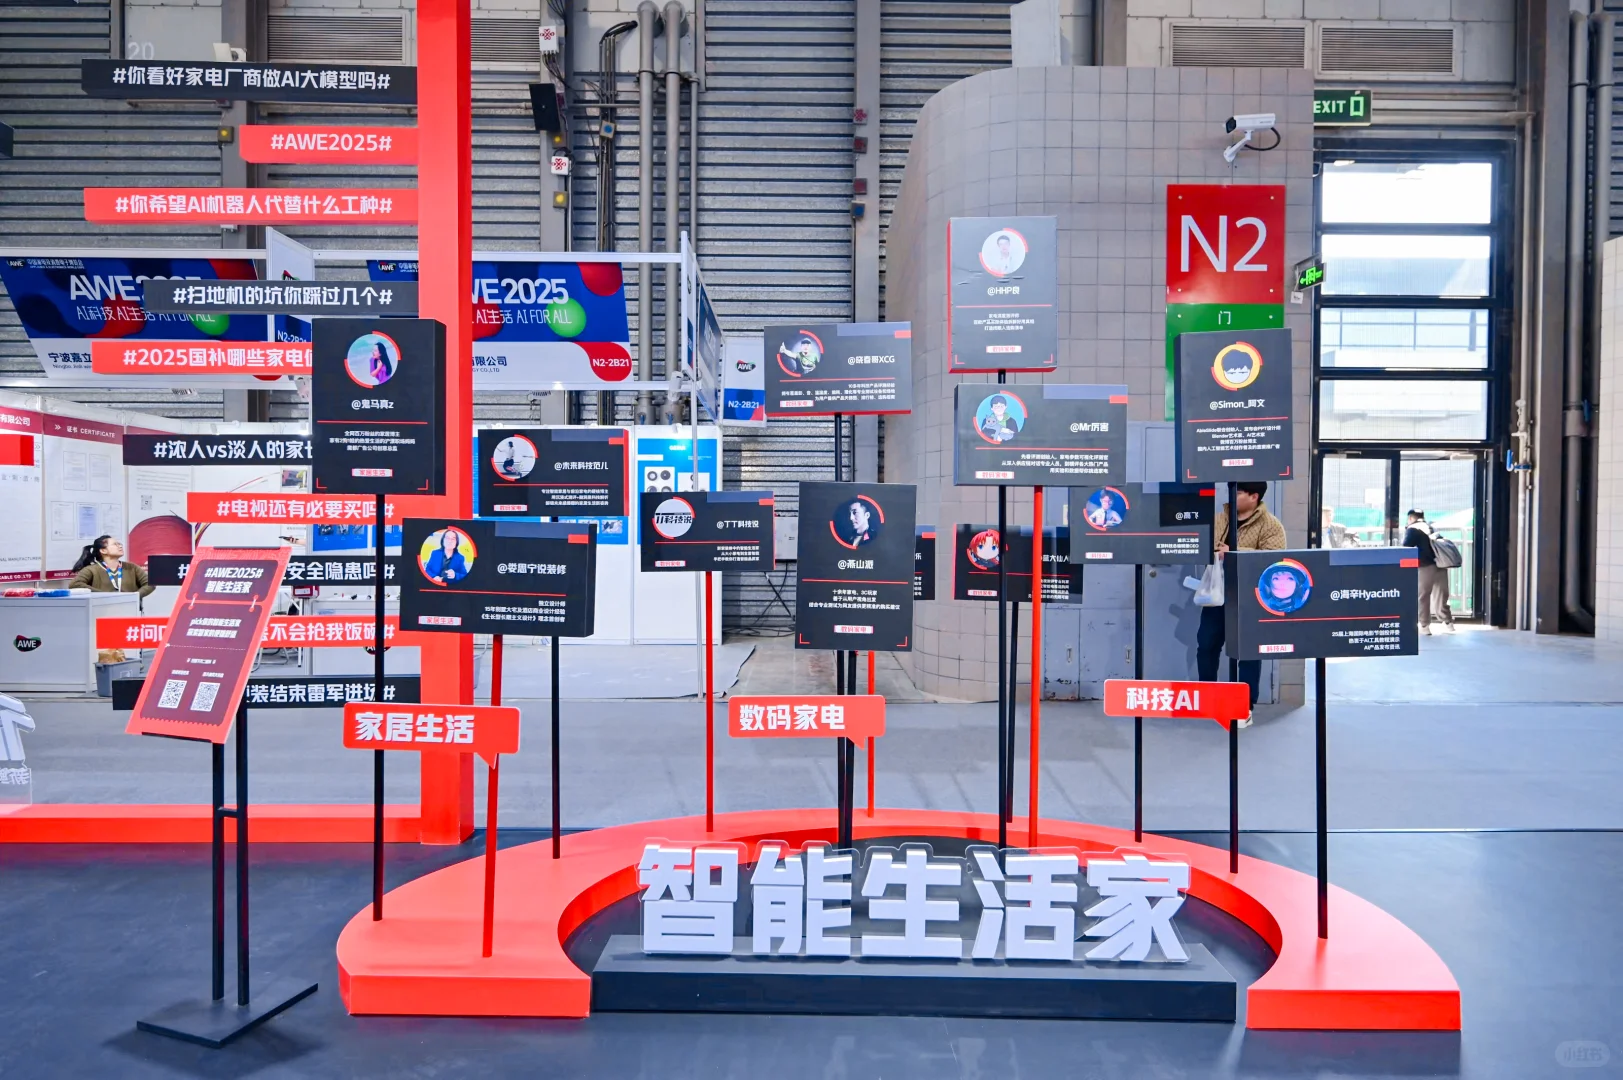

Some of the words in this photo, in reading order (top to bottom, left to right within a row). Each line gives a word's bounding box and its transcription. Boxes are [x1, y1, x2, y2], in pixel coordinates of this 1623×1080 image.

[113, 67, 391, 90] #你看好家电厂商做AI大模型吗#
[1313, 100, 1346, 114] EXIT
[271, 133, 392, 152] #AWE2025#
[116, 194, 392, 216] #你希望AI机器人代替什么工种#
[1180, 214, 1268, 273] N2
[173, 285, 393, 306] #扫地机的坑你踩过几个#
[476, 308, 513, 324] AI生活
[517, 309, 527, 324] AI
[530, 309, 551, 324] FOR
[553, 309, 572, 324] ALL
[1218, 310, 1231, 325] 门
[592, 357, 630, 367] N2-2B21
[727, 400, 760, 409] N2-2B21
[67, 425, 78, 434] 证书
[80, 428, 115, 438] CERTIFICATE
[1070, 422, 1109, 433] @Mr厉害
[554, 461, 609, 470] @未来科技范儿
[217, 500, 395, 519] #电视还有必要买吗#
[1040, 554, 1069, 562] 蓝大仙人
[204, 567, 264, 579] #AWE2025#
[204, 580, 253, 594] 智能生活家
[1330, 588, 1400, 601] @海辛Hyacinth
[17, 639, 37, 649] AWE
[246, 684, 396, 703] 装结束雷军进场#
[1126, 686, 1200, 713] 科技AI
[738, 703, 846, 732] 数码家电
[355, 711, 475, 744] 家居生活
[638, 842, 1191, 963] 智能生活家
